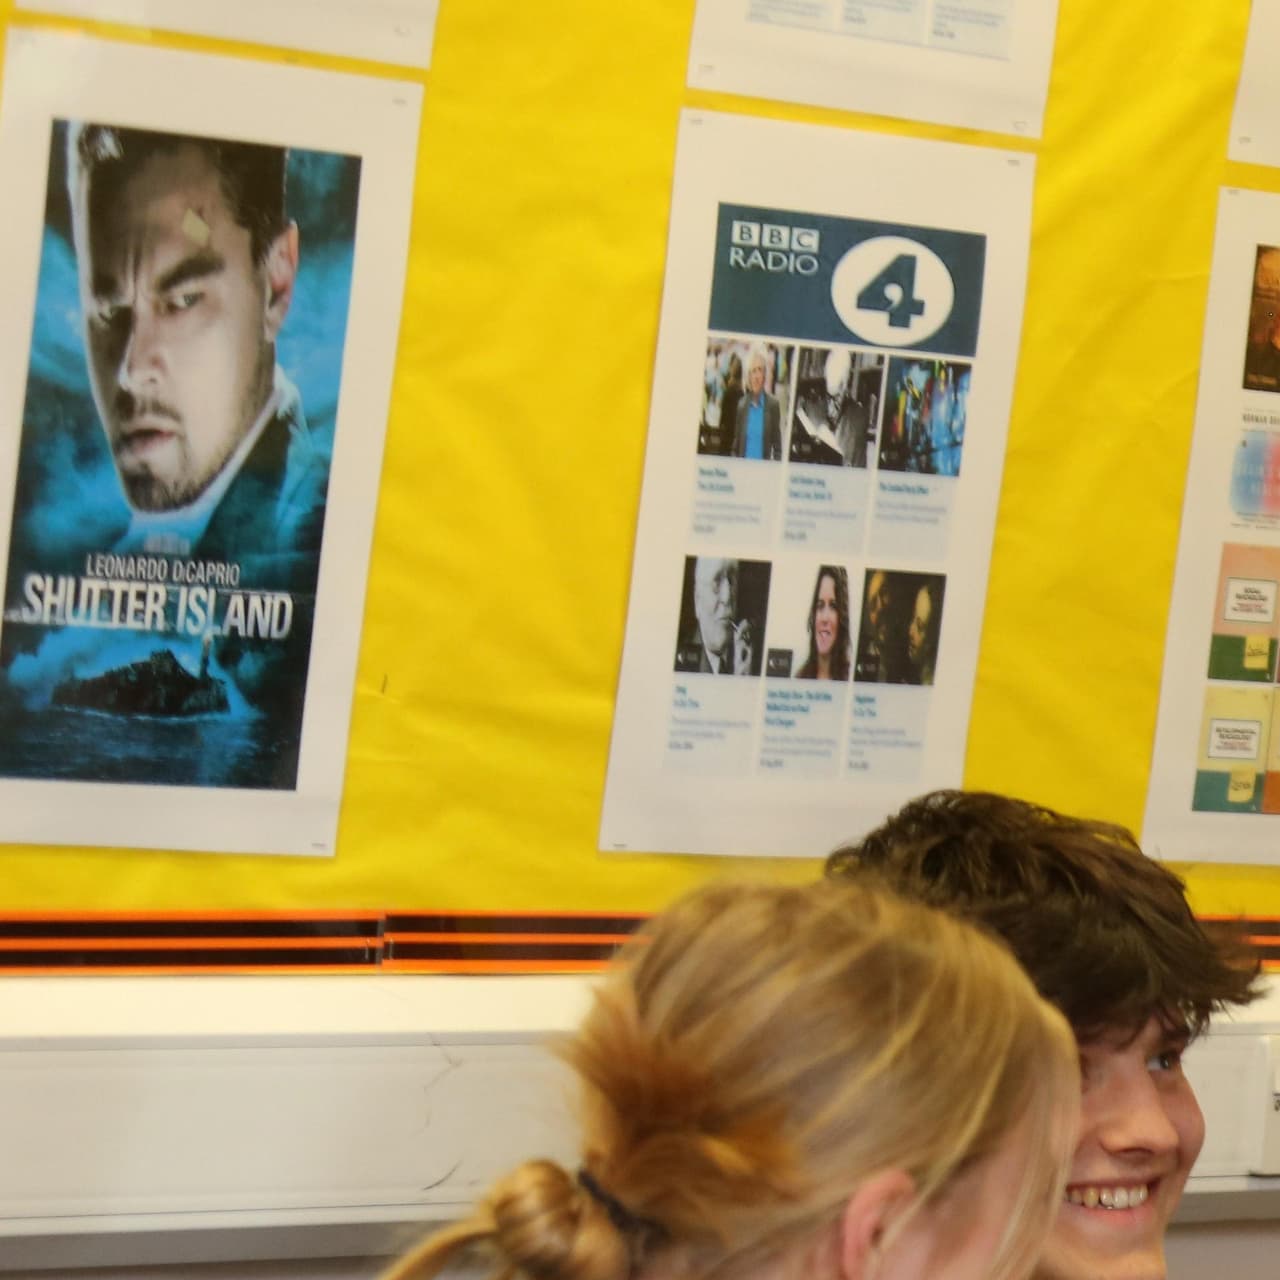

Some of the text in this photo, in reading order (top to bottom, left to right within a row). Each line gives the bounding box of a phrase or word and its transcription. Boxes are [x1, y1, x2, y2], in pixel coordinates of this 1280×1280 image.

[733, 221, 819, 254] BBC
[729, 246, 819, 276] RADIO
[856, 253, 926, 329] 4
[86, 553, 168, 581] LEONARDO
[22, 572, 294, 640] SHUTTER ISLAND
